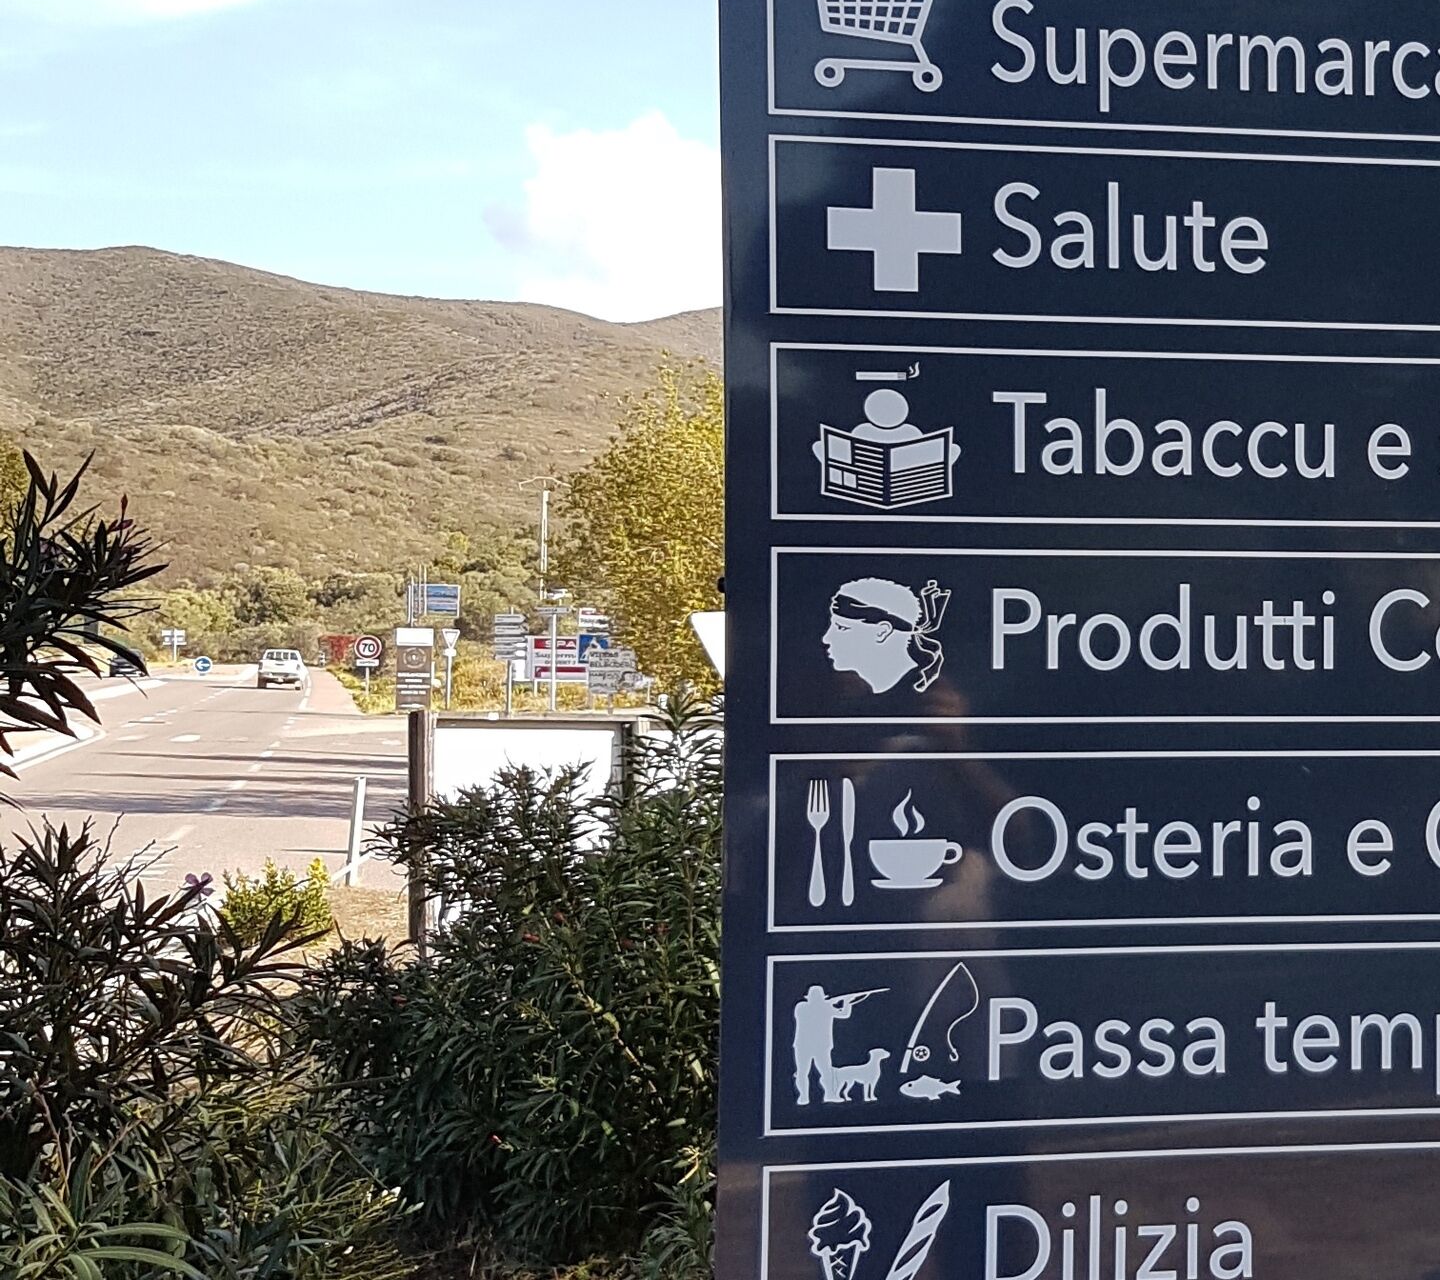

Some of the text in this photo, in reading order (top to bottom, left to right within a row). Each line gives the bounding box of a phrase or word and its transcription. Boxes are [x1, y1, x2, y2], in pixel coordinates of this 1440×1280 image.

[992, 181, 1269, 274] Salute
[992, 387, 1335, 479] Tabaccu
[1367, 423, 1412, 480] e
[361, 643, 376, 653] 70
[992, 583, 1336, 671] Produtti
[990, 795, 1313, 882] Osteria
[1346, 821, 1394, 877] e
[988, 997, 1226, 1082] Passa
